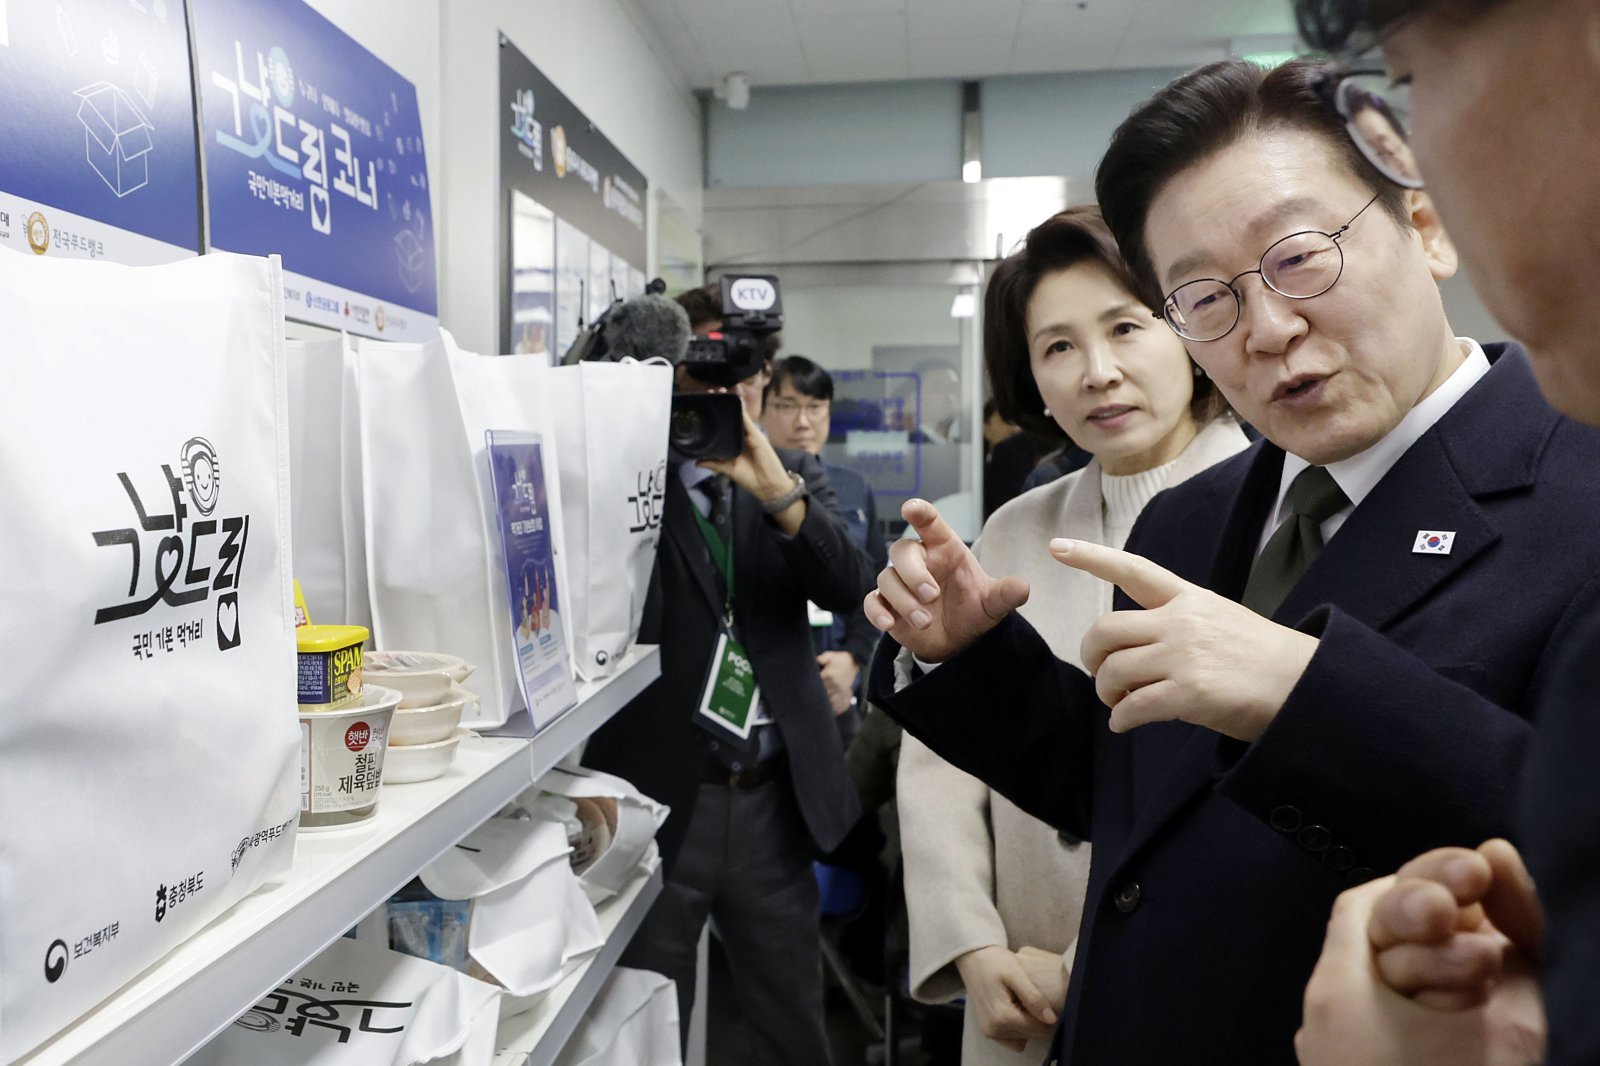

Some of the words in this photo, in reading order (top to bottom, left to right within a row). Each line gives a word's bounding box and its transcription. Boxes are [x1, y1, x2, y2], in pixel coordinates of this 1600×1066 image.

[738, 286, 767, 300] KTV
[91, 437, 250, 651] 그냥드림
[132, 629, 154, 661] 국민
[155, 626, 174, 653] 기본
[176, 617, 204, 648] 먹거리
[333, 645, 364, 677] SPAM
[347, 729, 369, 746] 햇반
[354, 752, 376, 775] 철판
[338, 768, 382, 794] 제육덮밥
[168, 871, 204, 908] 충청북도
[73, 920, 120, 960] 보건복지부
